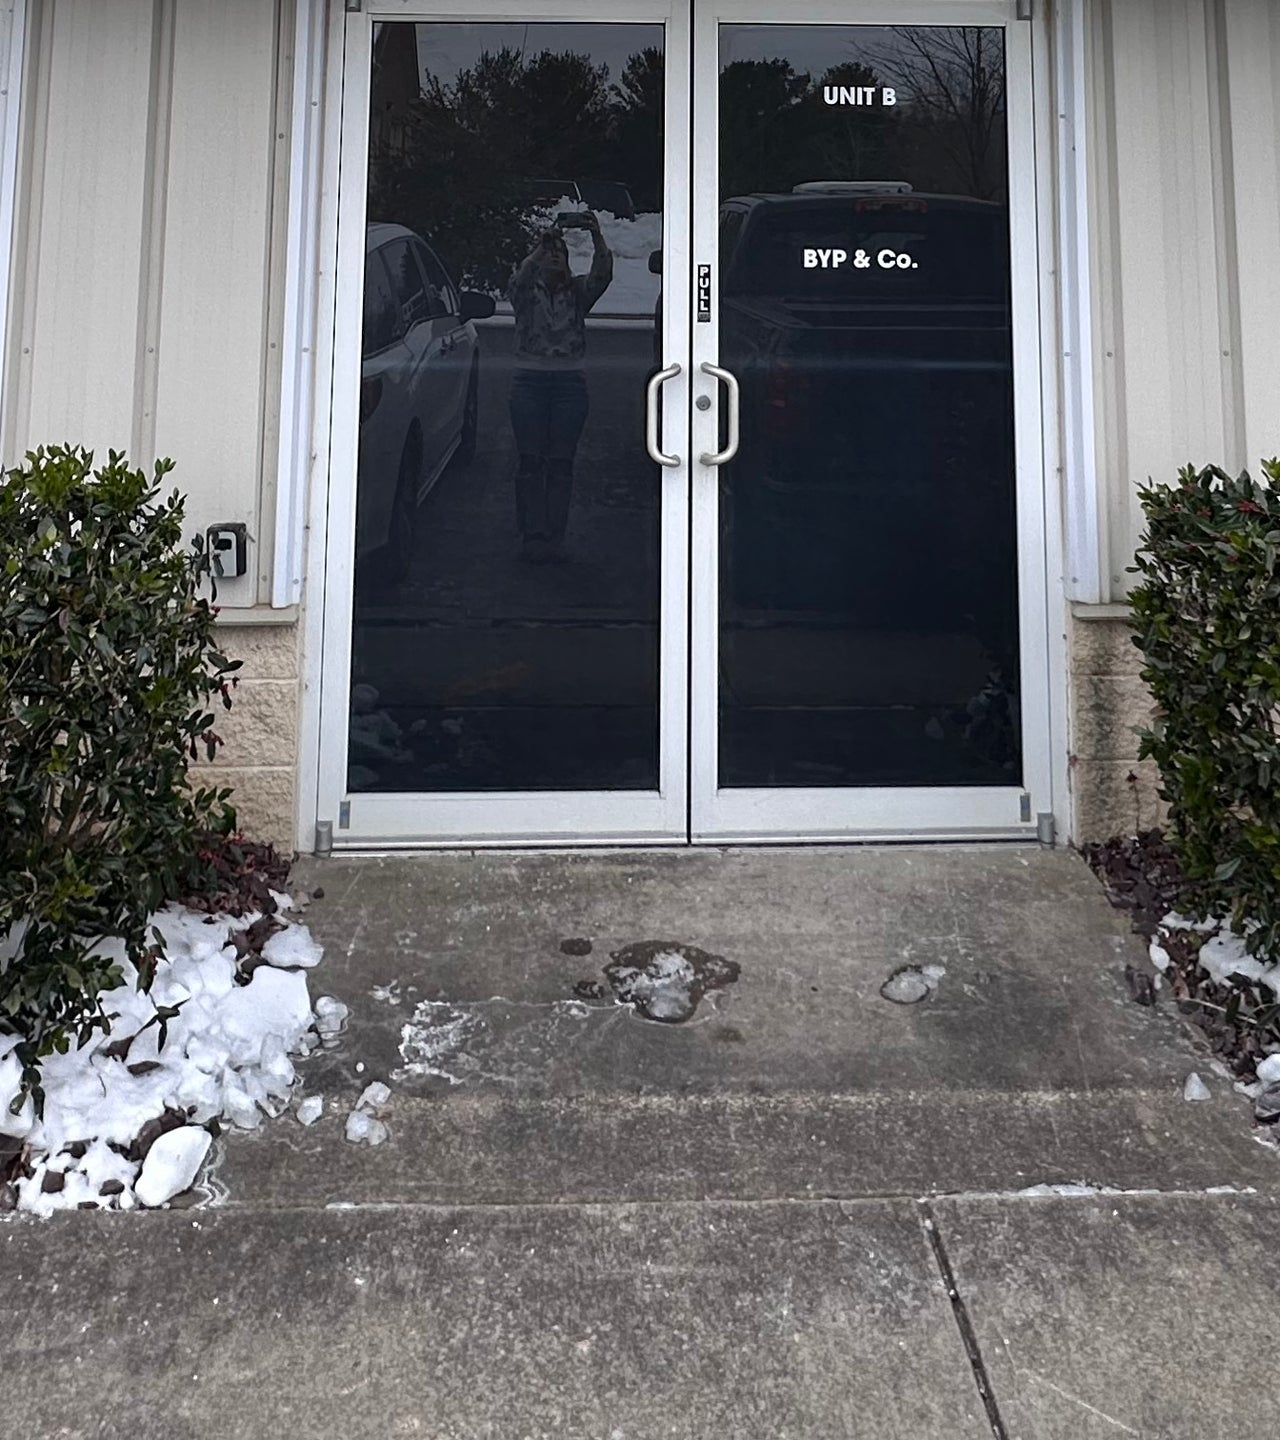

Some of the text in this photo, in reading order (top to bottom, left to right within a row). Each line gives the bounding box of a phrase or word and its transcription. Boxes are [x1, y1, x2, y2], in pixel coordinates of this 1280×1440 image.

[823, 86, 897, 106] UNIT B
[803, 248, 919, 270] BYP & Co.
[699, 266, 710, 311] PULL
